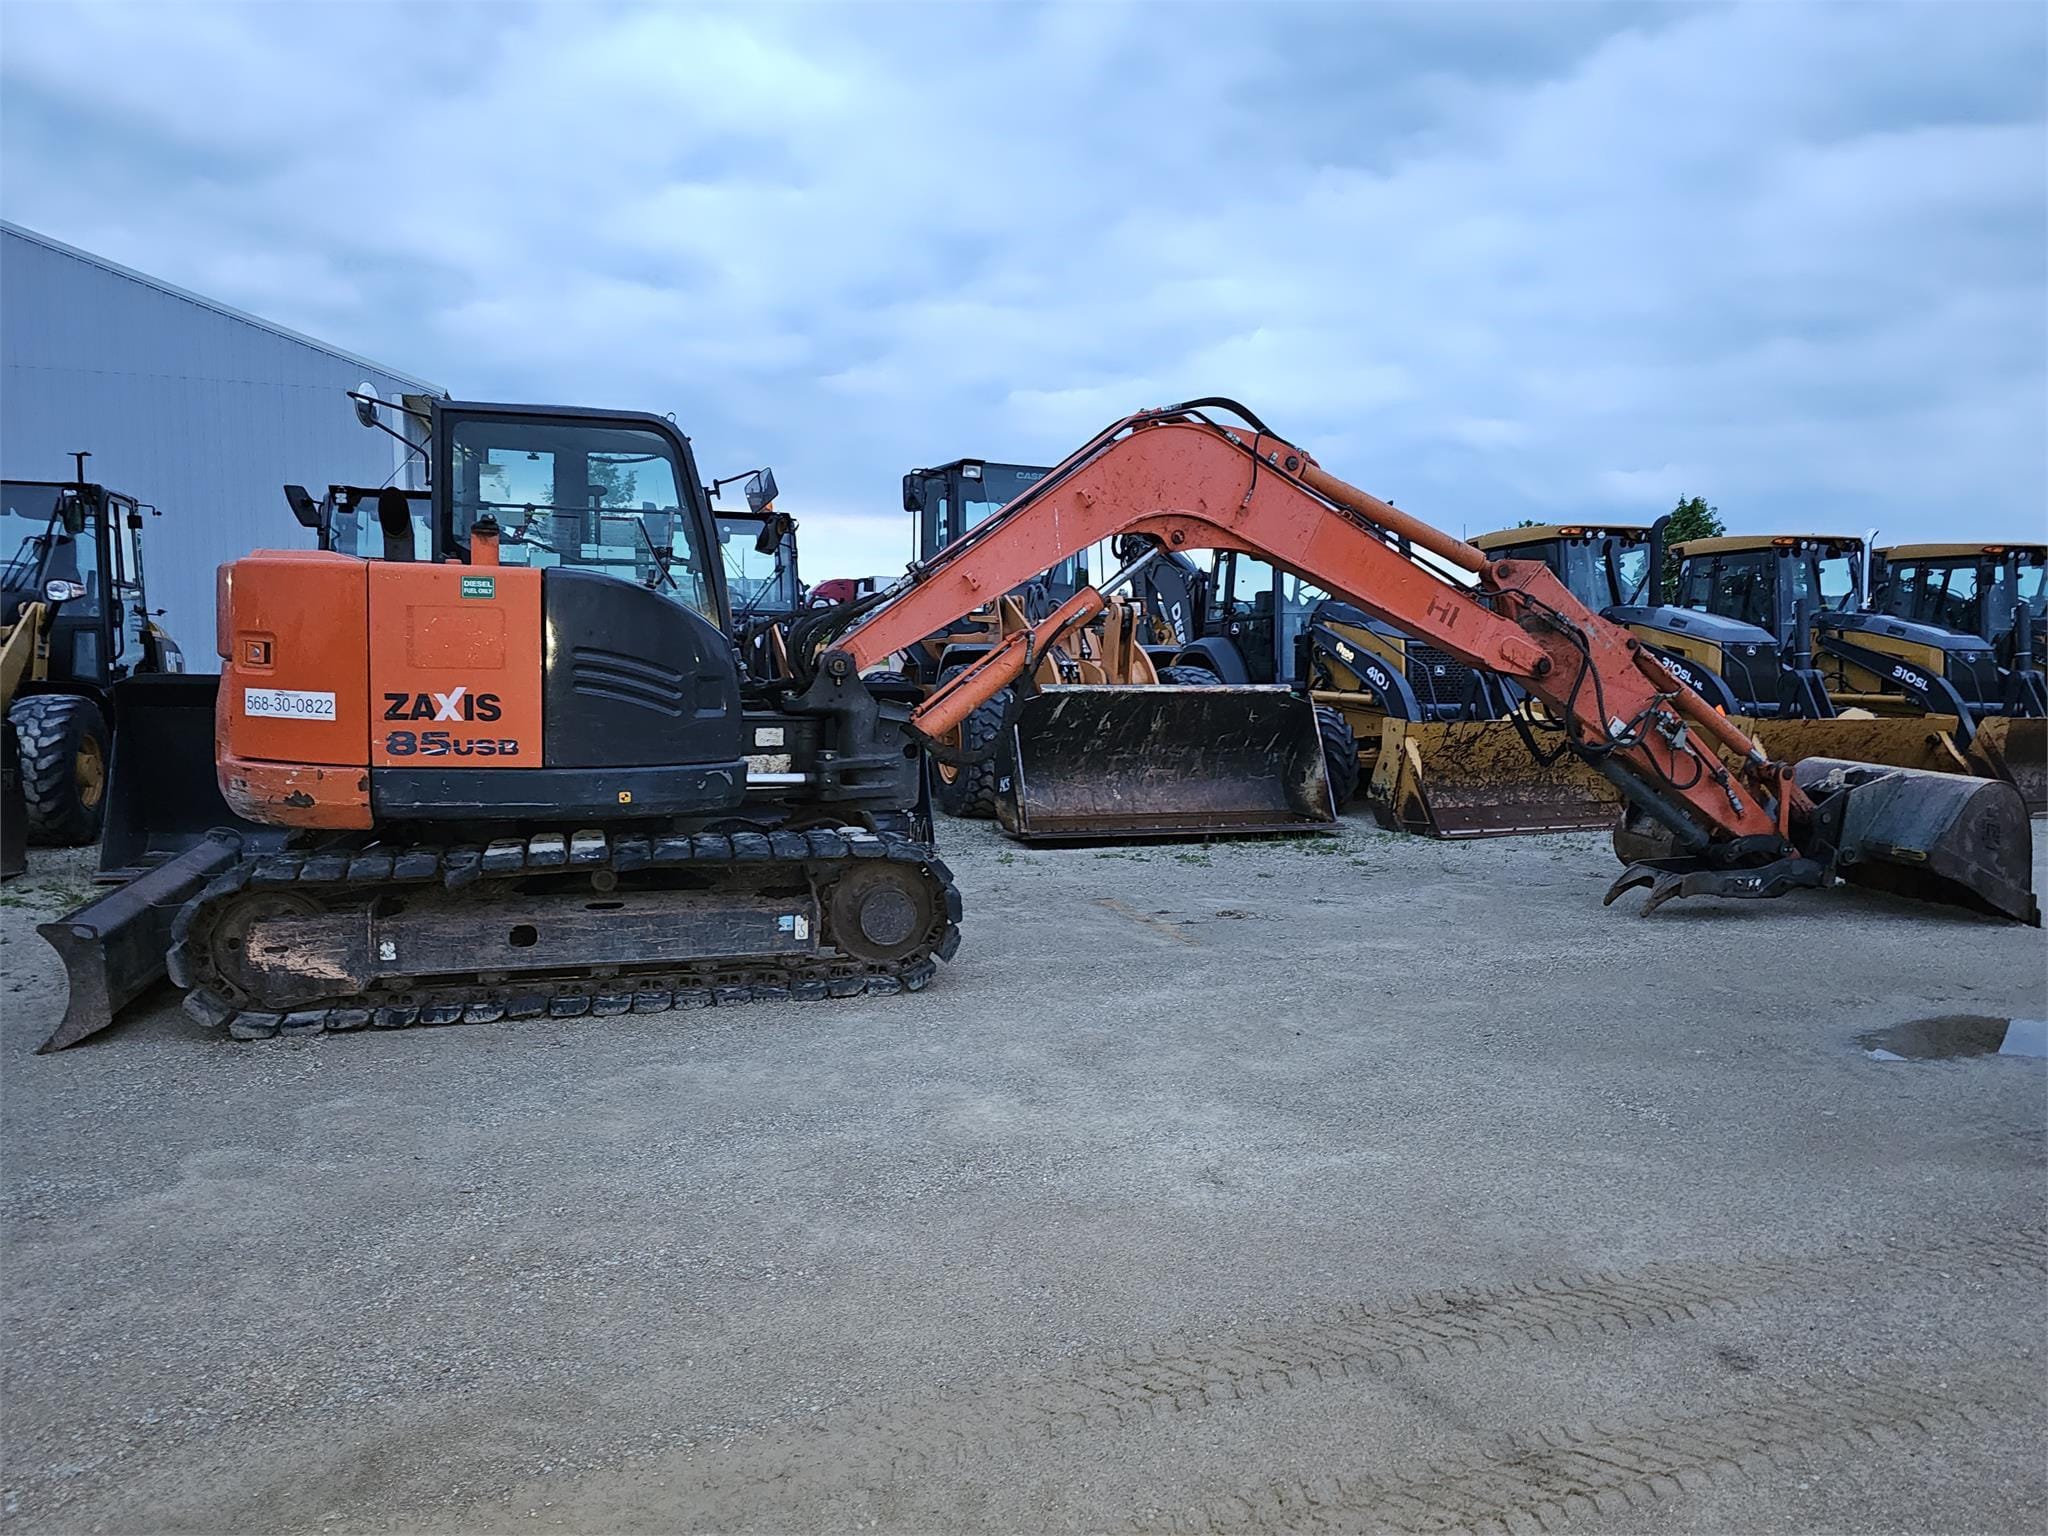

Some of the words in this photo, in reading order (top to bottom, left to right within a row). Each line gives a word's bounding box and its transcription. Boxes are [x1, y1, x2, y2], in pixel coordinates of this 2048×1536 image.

[463, 580, 493, 588] DIESEL
[1366, 666, 1390, 690] 410J
[1662, 656, 1693, 684] 310SL
[1892, 665, 1929, 691] 310SL
[246, 695, 333, 714] 568-30-0822
[384, 686, 502, 721] ZAXIS
